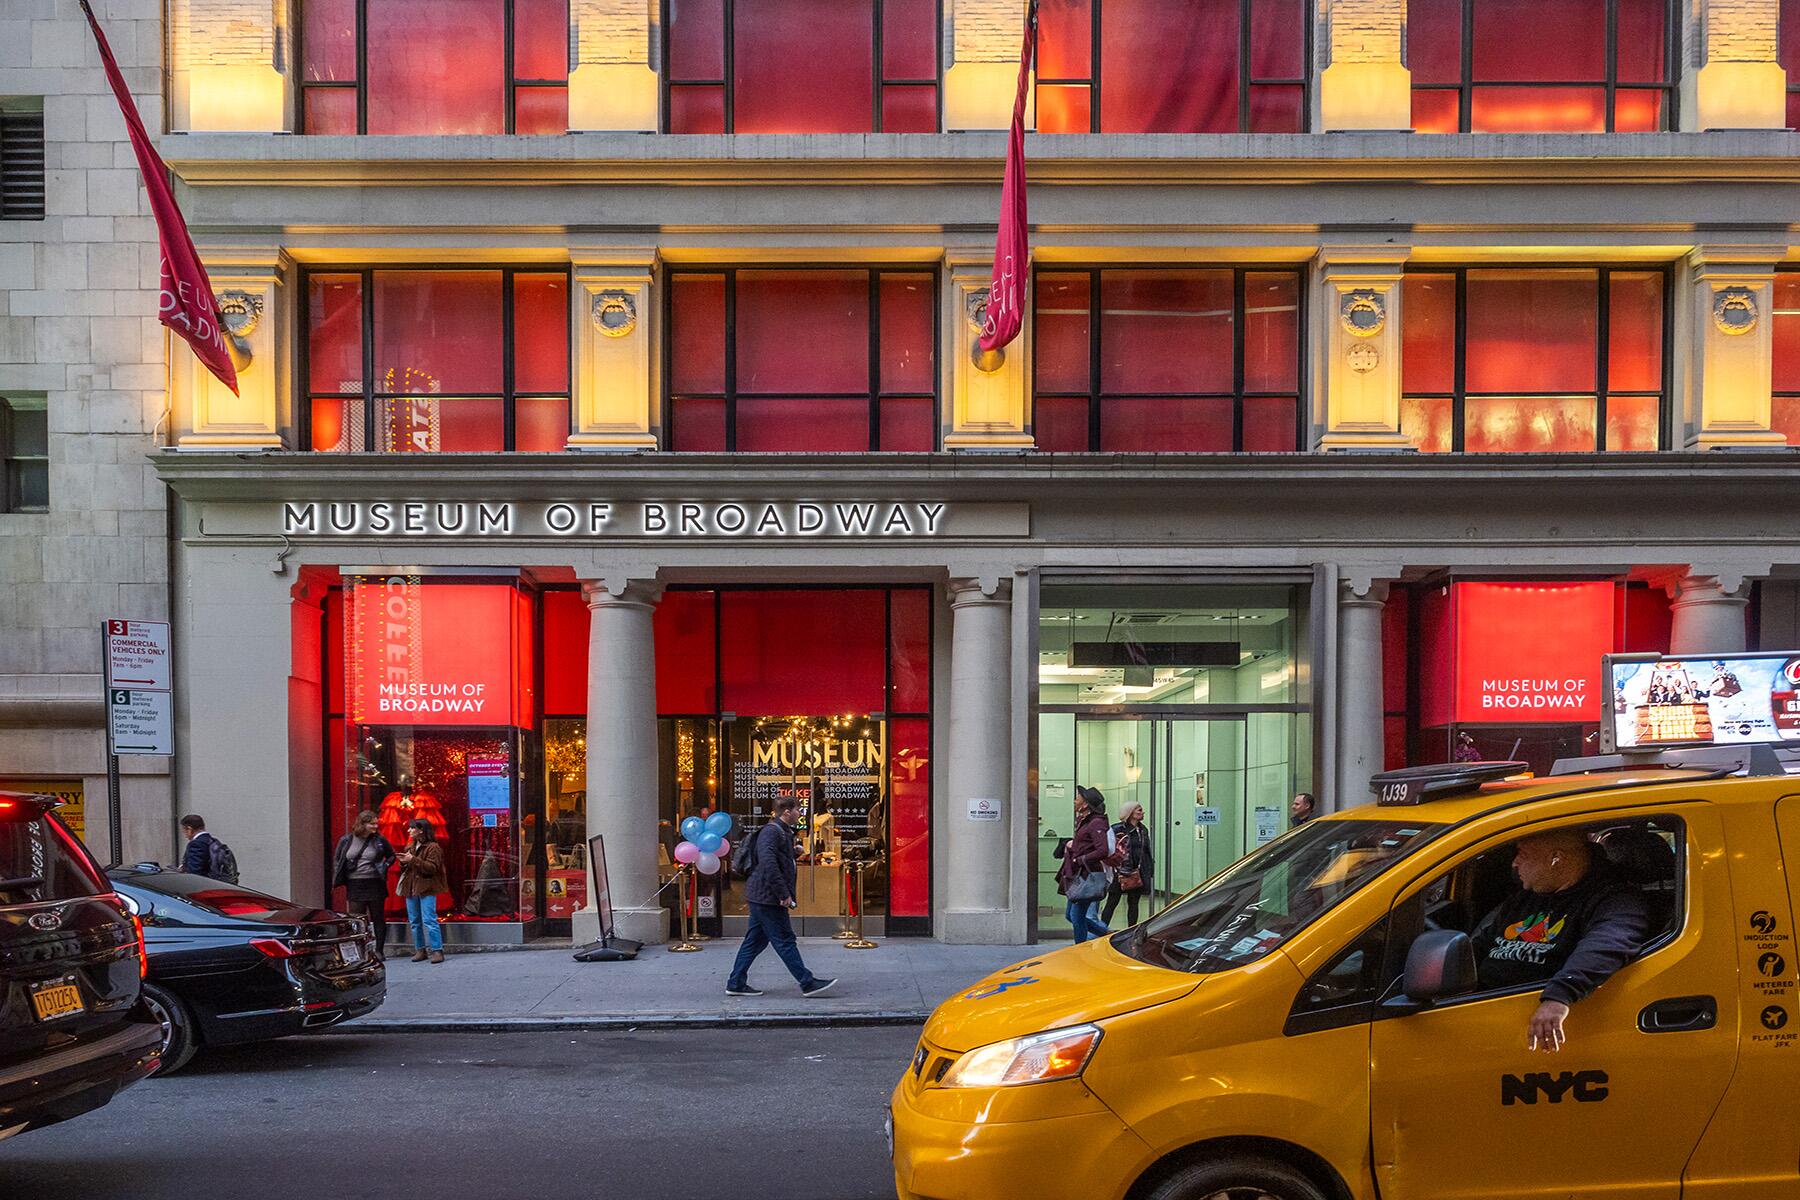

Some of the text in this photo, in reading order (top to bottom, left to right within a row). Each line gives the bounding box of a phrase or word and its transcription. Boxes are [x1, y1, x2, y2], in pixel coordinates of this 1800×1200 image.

[284, 503, 944, 532] MUSEUM OF BROADWAY
[113, 621, 123, 634] 3
[112, 639, 158, 648] COMMERCIAL
[112, 646, 146, 655] VEHICLES
[380, 683, 485, 696] MUSEUM OF
[1483, 679, 1586, 692] MUSEUM OF
[116, 691, 126, 704] 6
[1482, 695, 1586, 708] BROADWAY
[380, 699, 485, 712] BROADWAY
[1382, 783, 1408, 802] 1J39
[1753, 981, 1794, 989] METERED
[35, 988, 77, 1012] T751225C
[1502, 1070, 1609, 1105] NYC
